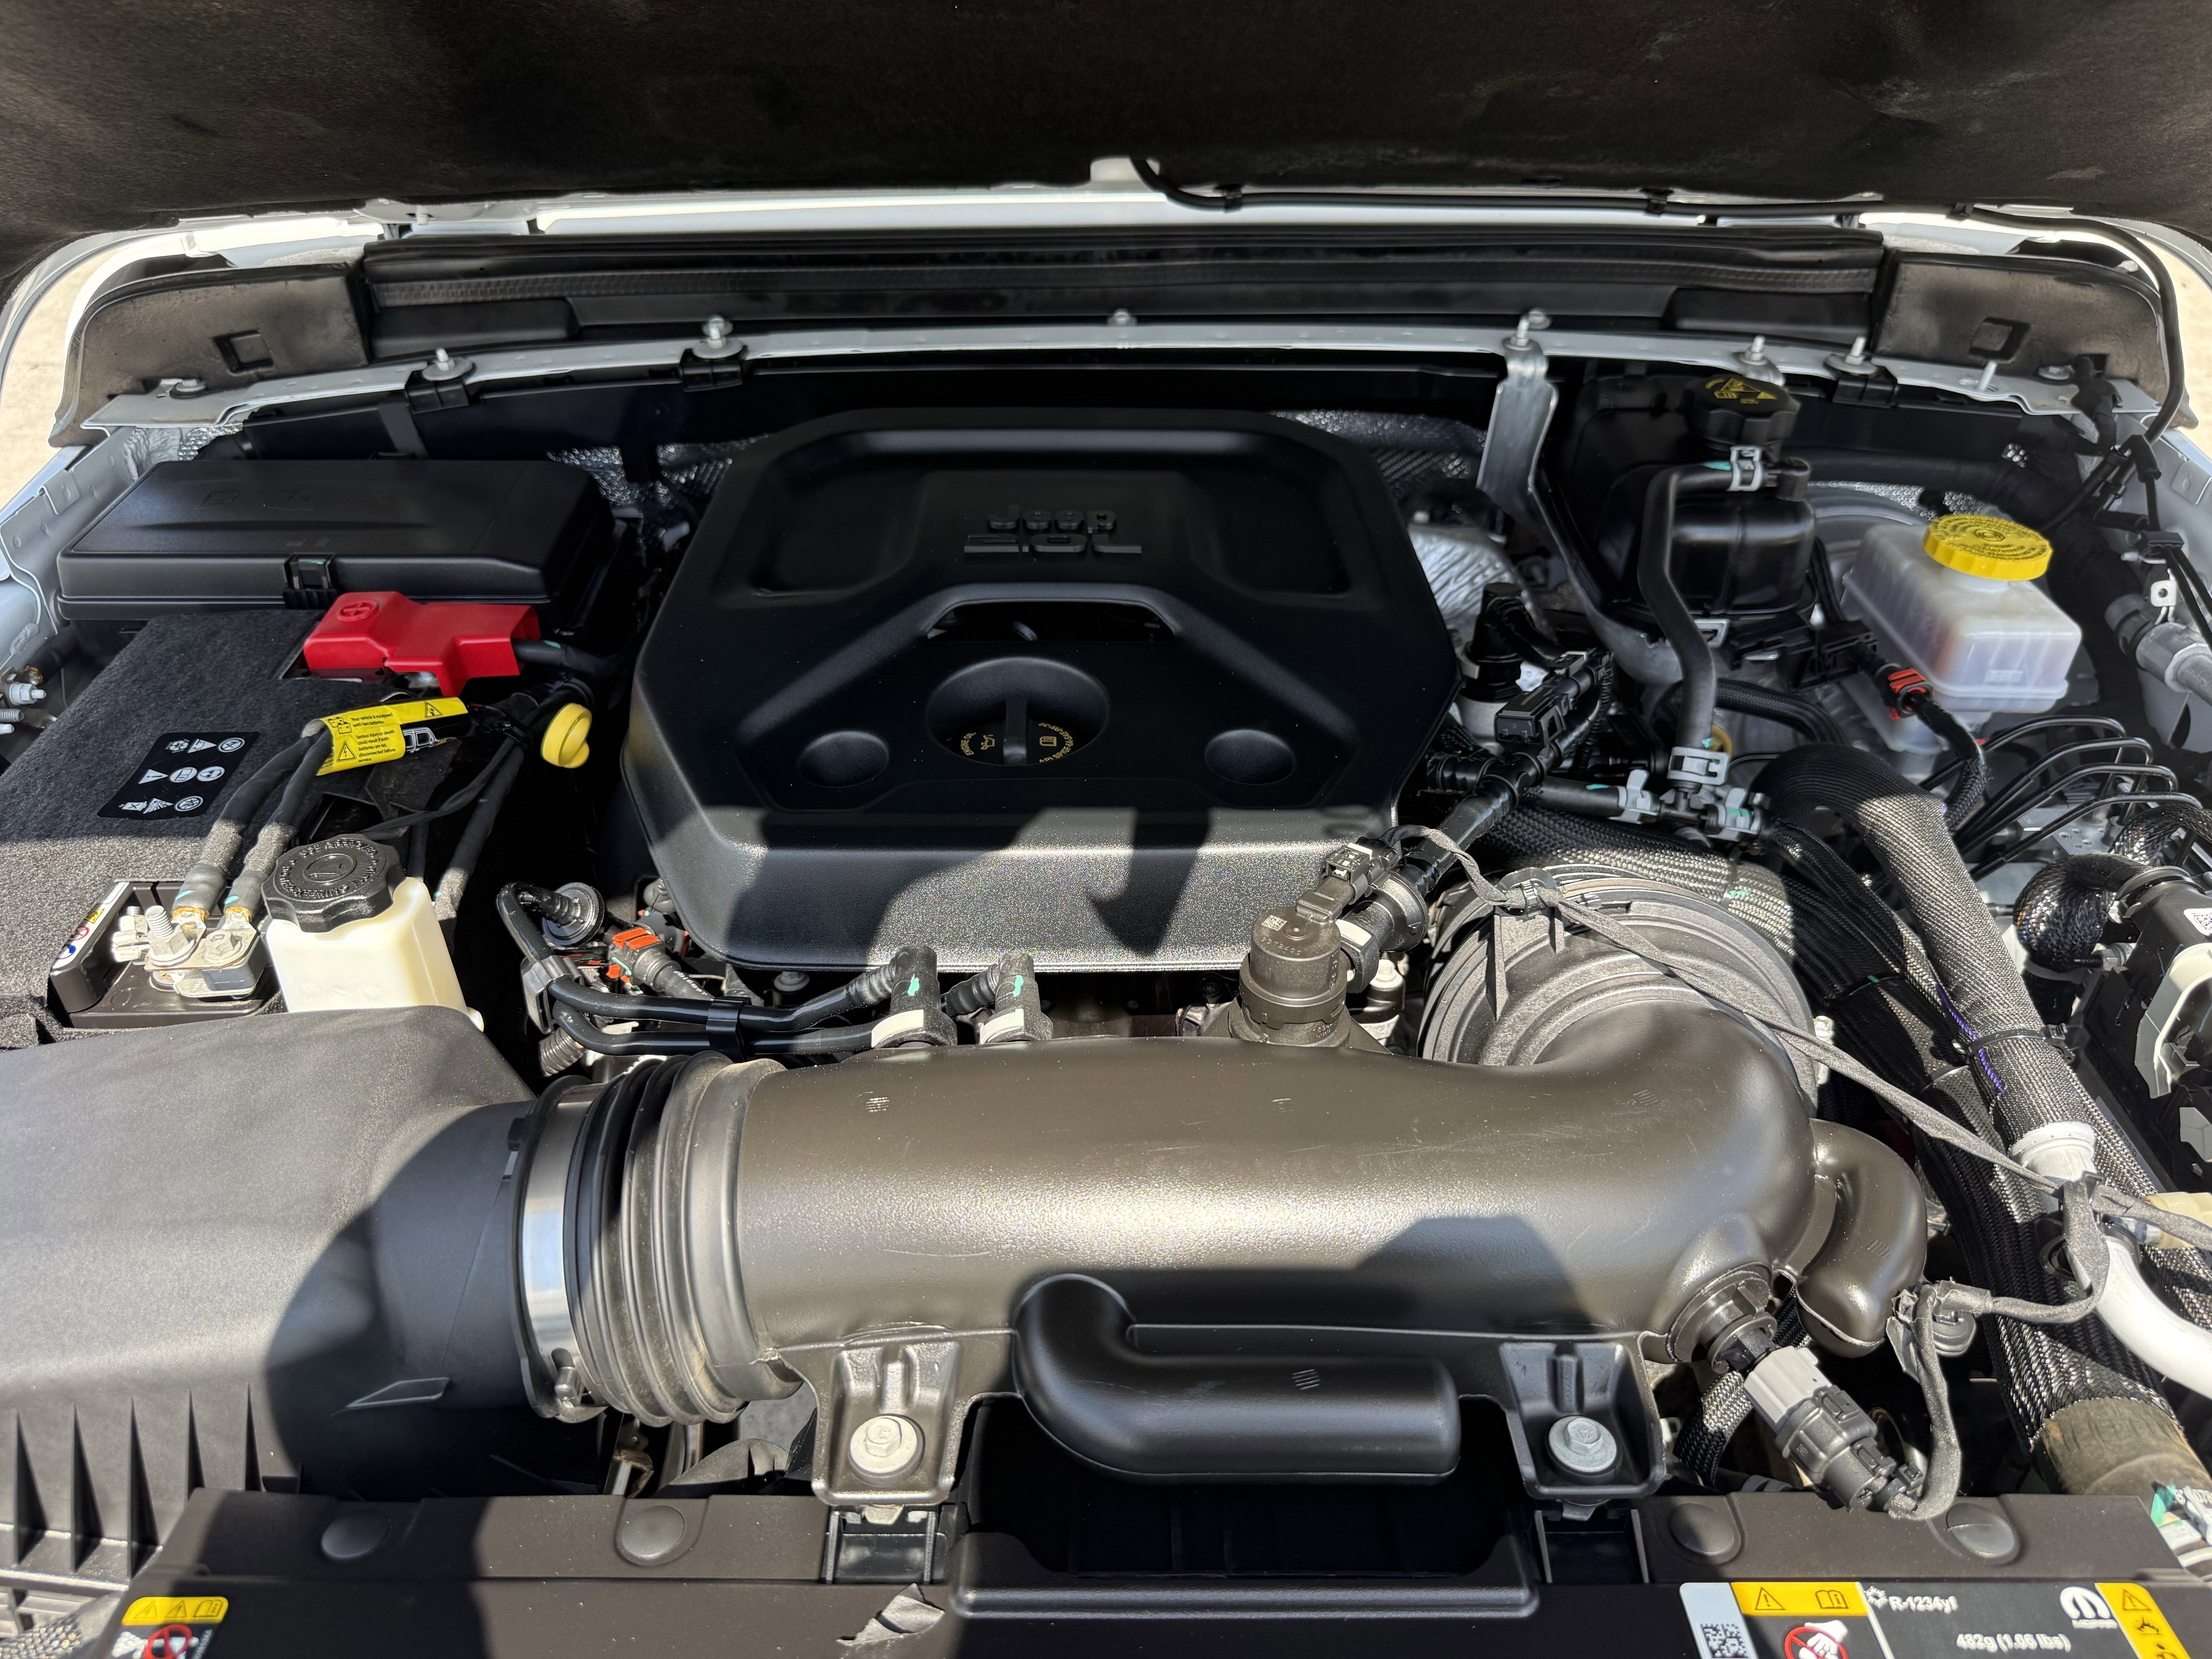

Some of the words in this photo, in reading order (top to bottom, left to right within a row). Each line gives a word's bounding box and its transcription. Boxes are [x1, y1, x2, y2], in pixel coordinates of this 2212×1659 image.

[986, 505, 1116, 534] Jeep
[359, 749, 384, 757] disconnected
[960, 740, 974, 756] ENGINE
[299, 844, 321, 858] USE
[325, 839, 378, 858] APPROVED
[1888, 1596, 1958, 1614] R-1234yf
[1956, 1633, 1998, 1652] 482g
[2036, 1633, 2072, 1653] lbs)
